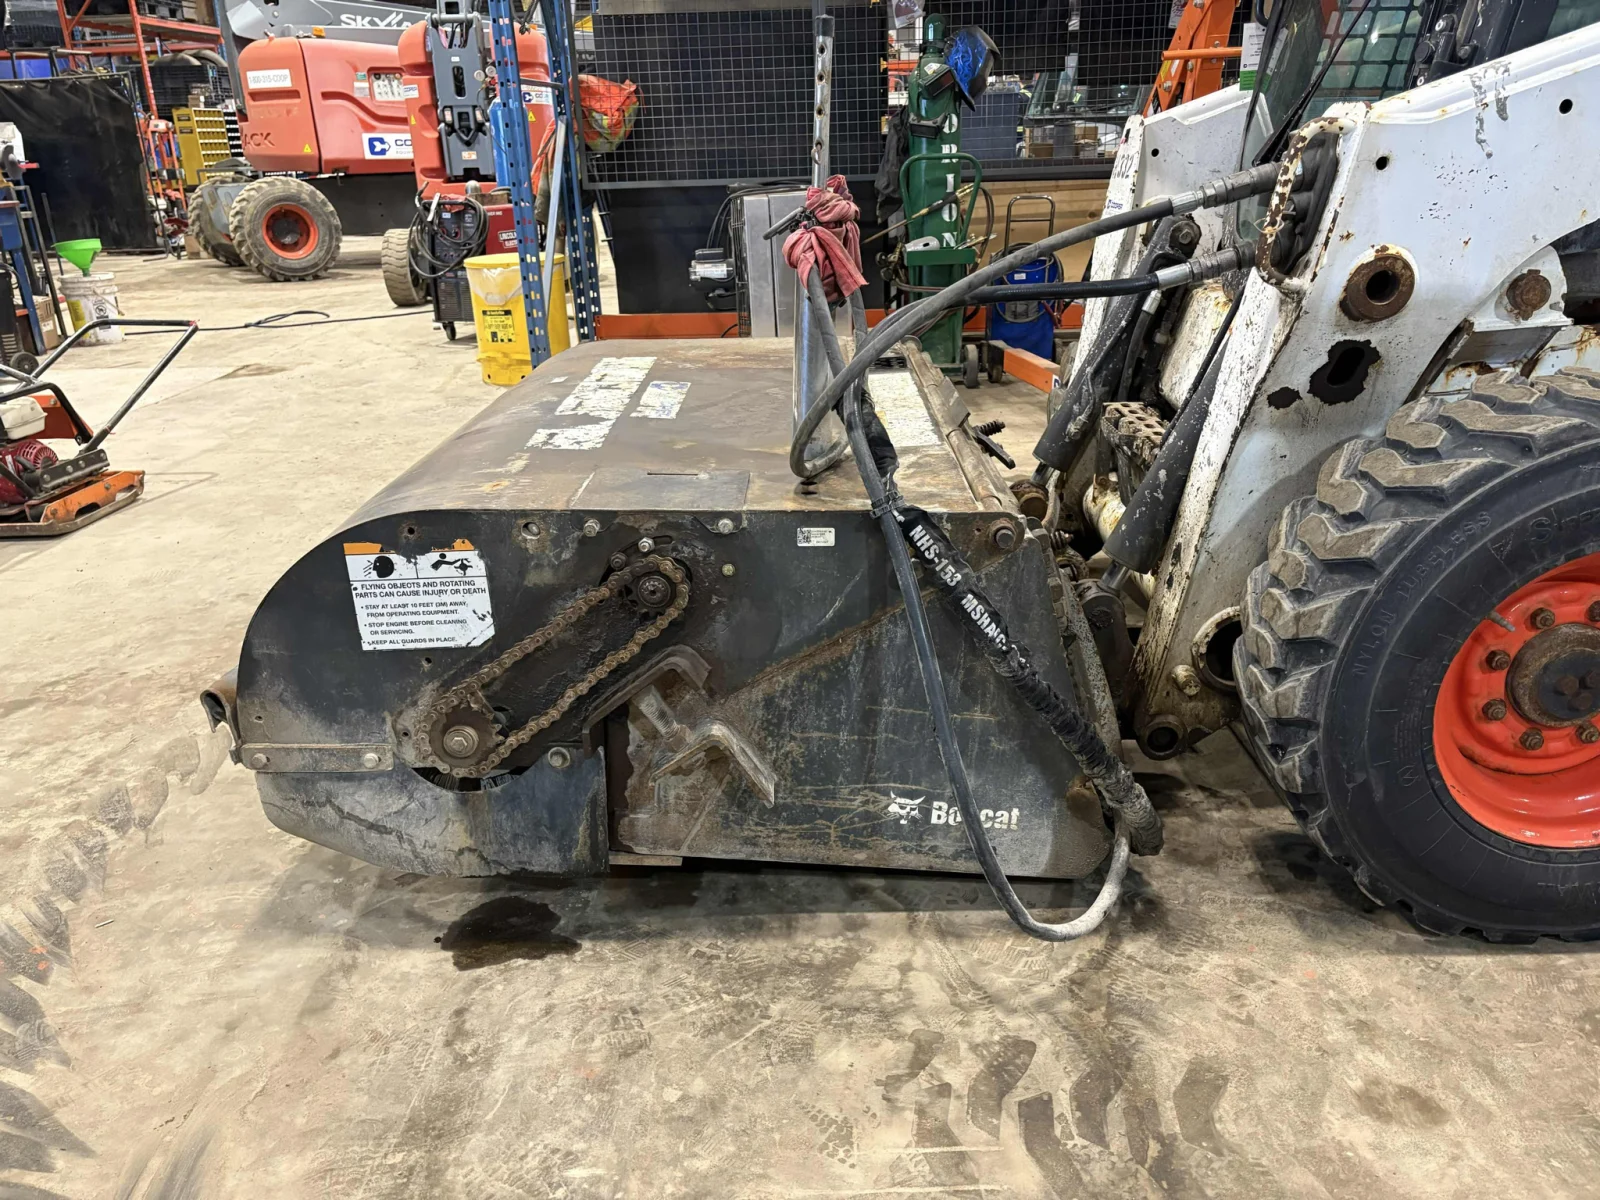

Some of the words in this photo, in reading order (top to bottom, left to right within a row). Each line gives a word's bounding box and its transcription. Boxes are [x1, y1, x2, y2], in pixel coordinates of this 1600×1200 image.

[940, 113, 960, 248] ORION
[908, 524, 962, 587] NHS-153
[355, 591, 378, 599] PARTS
[379, 590, 395, 598] CAN
[396, 589, 421, 597] CAUSE
[422, 588, 449, 596] INJURY
[462, 587, 487, 595] DEATH
[361, 583, 386, 591] FLYING
[387, 581, 421, 589] OBJECTS
[439, 579, 476, 588] ROTATING
[1352, 609, 1396, 675] NYLON
[930, 801, 1020, 831] Bocat
